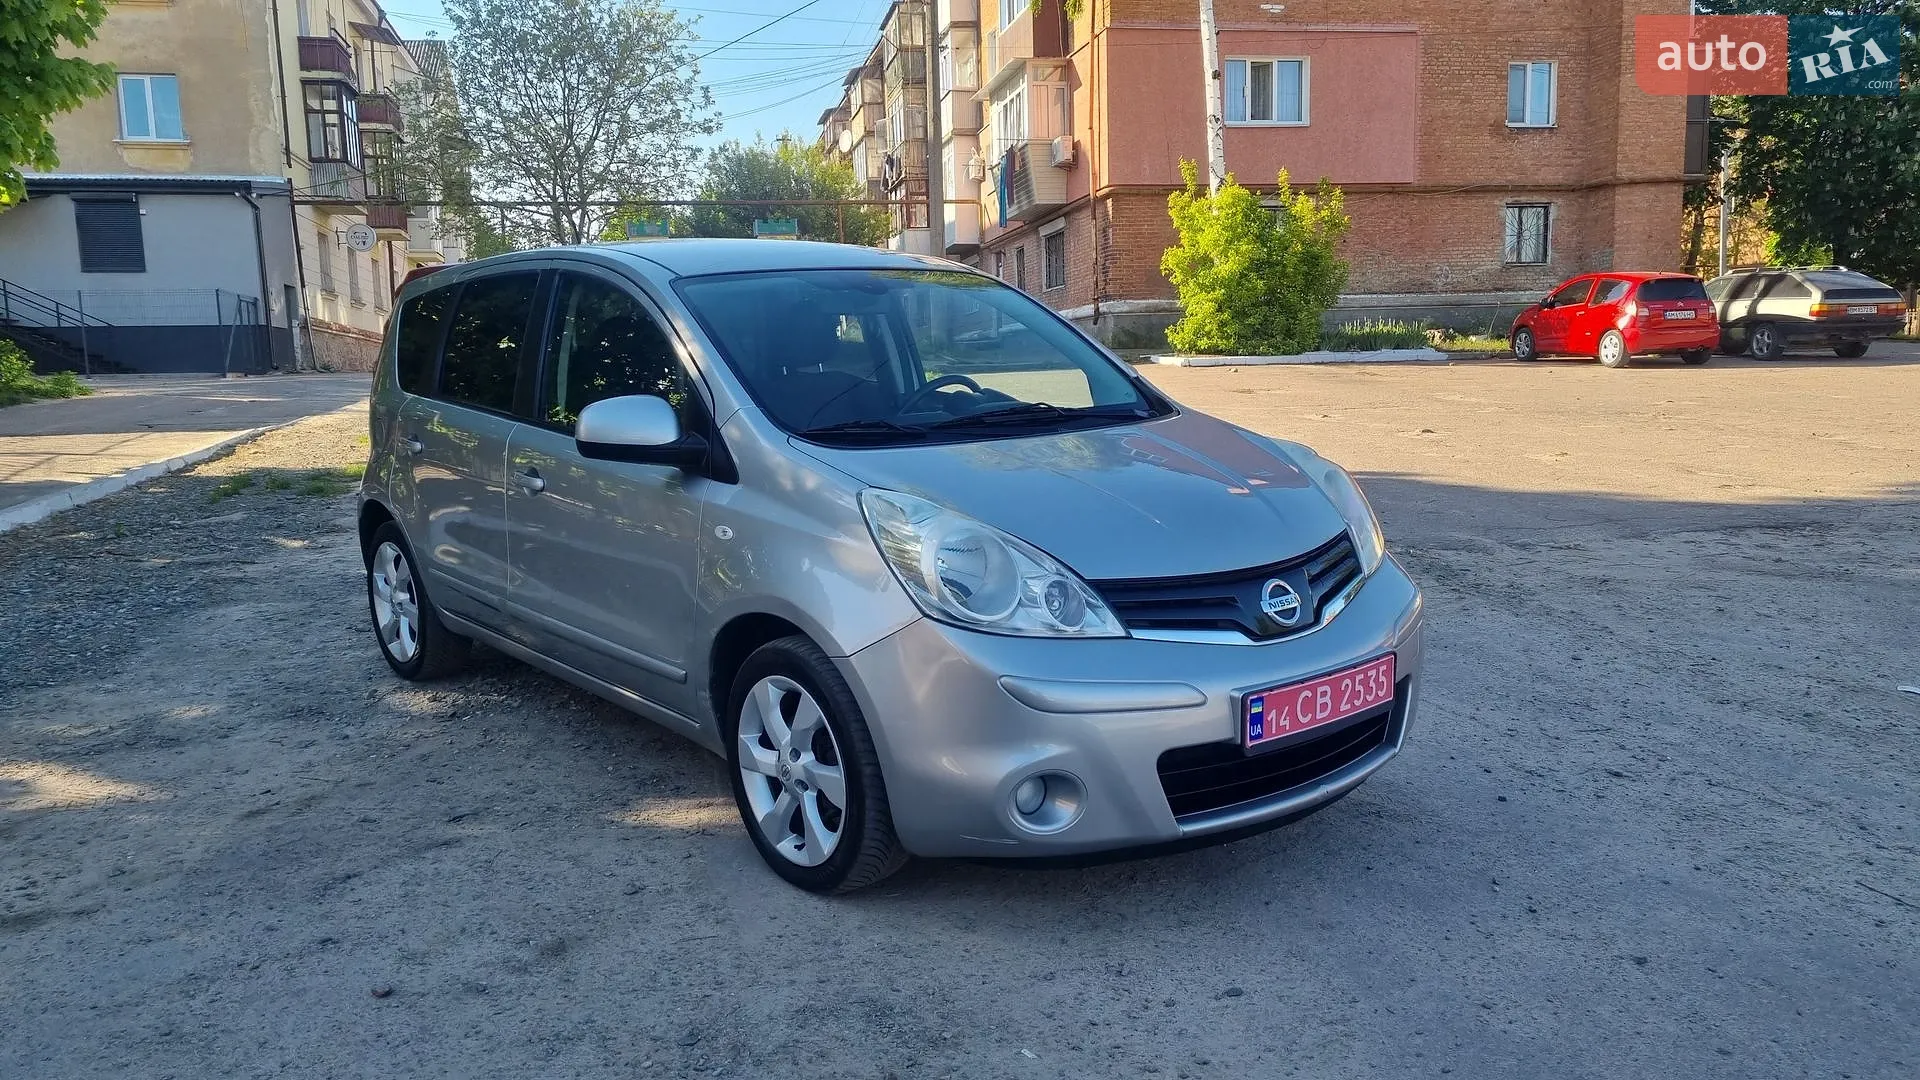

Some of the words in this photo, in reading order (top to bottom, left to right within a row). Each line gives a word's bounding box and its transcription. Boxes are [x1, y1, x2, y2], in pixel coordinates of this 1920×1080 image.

[1267, 706, 1290, 734] 14
[1296, 685, 1332, 723] CB
[1339, 665, 1387, 712] 2535
[1250, 724, 1262, 736] UA
